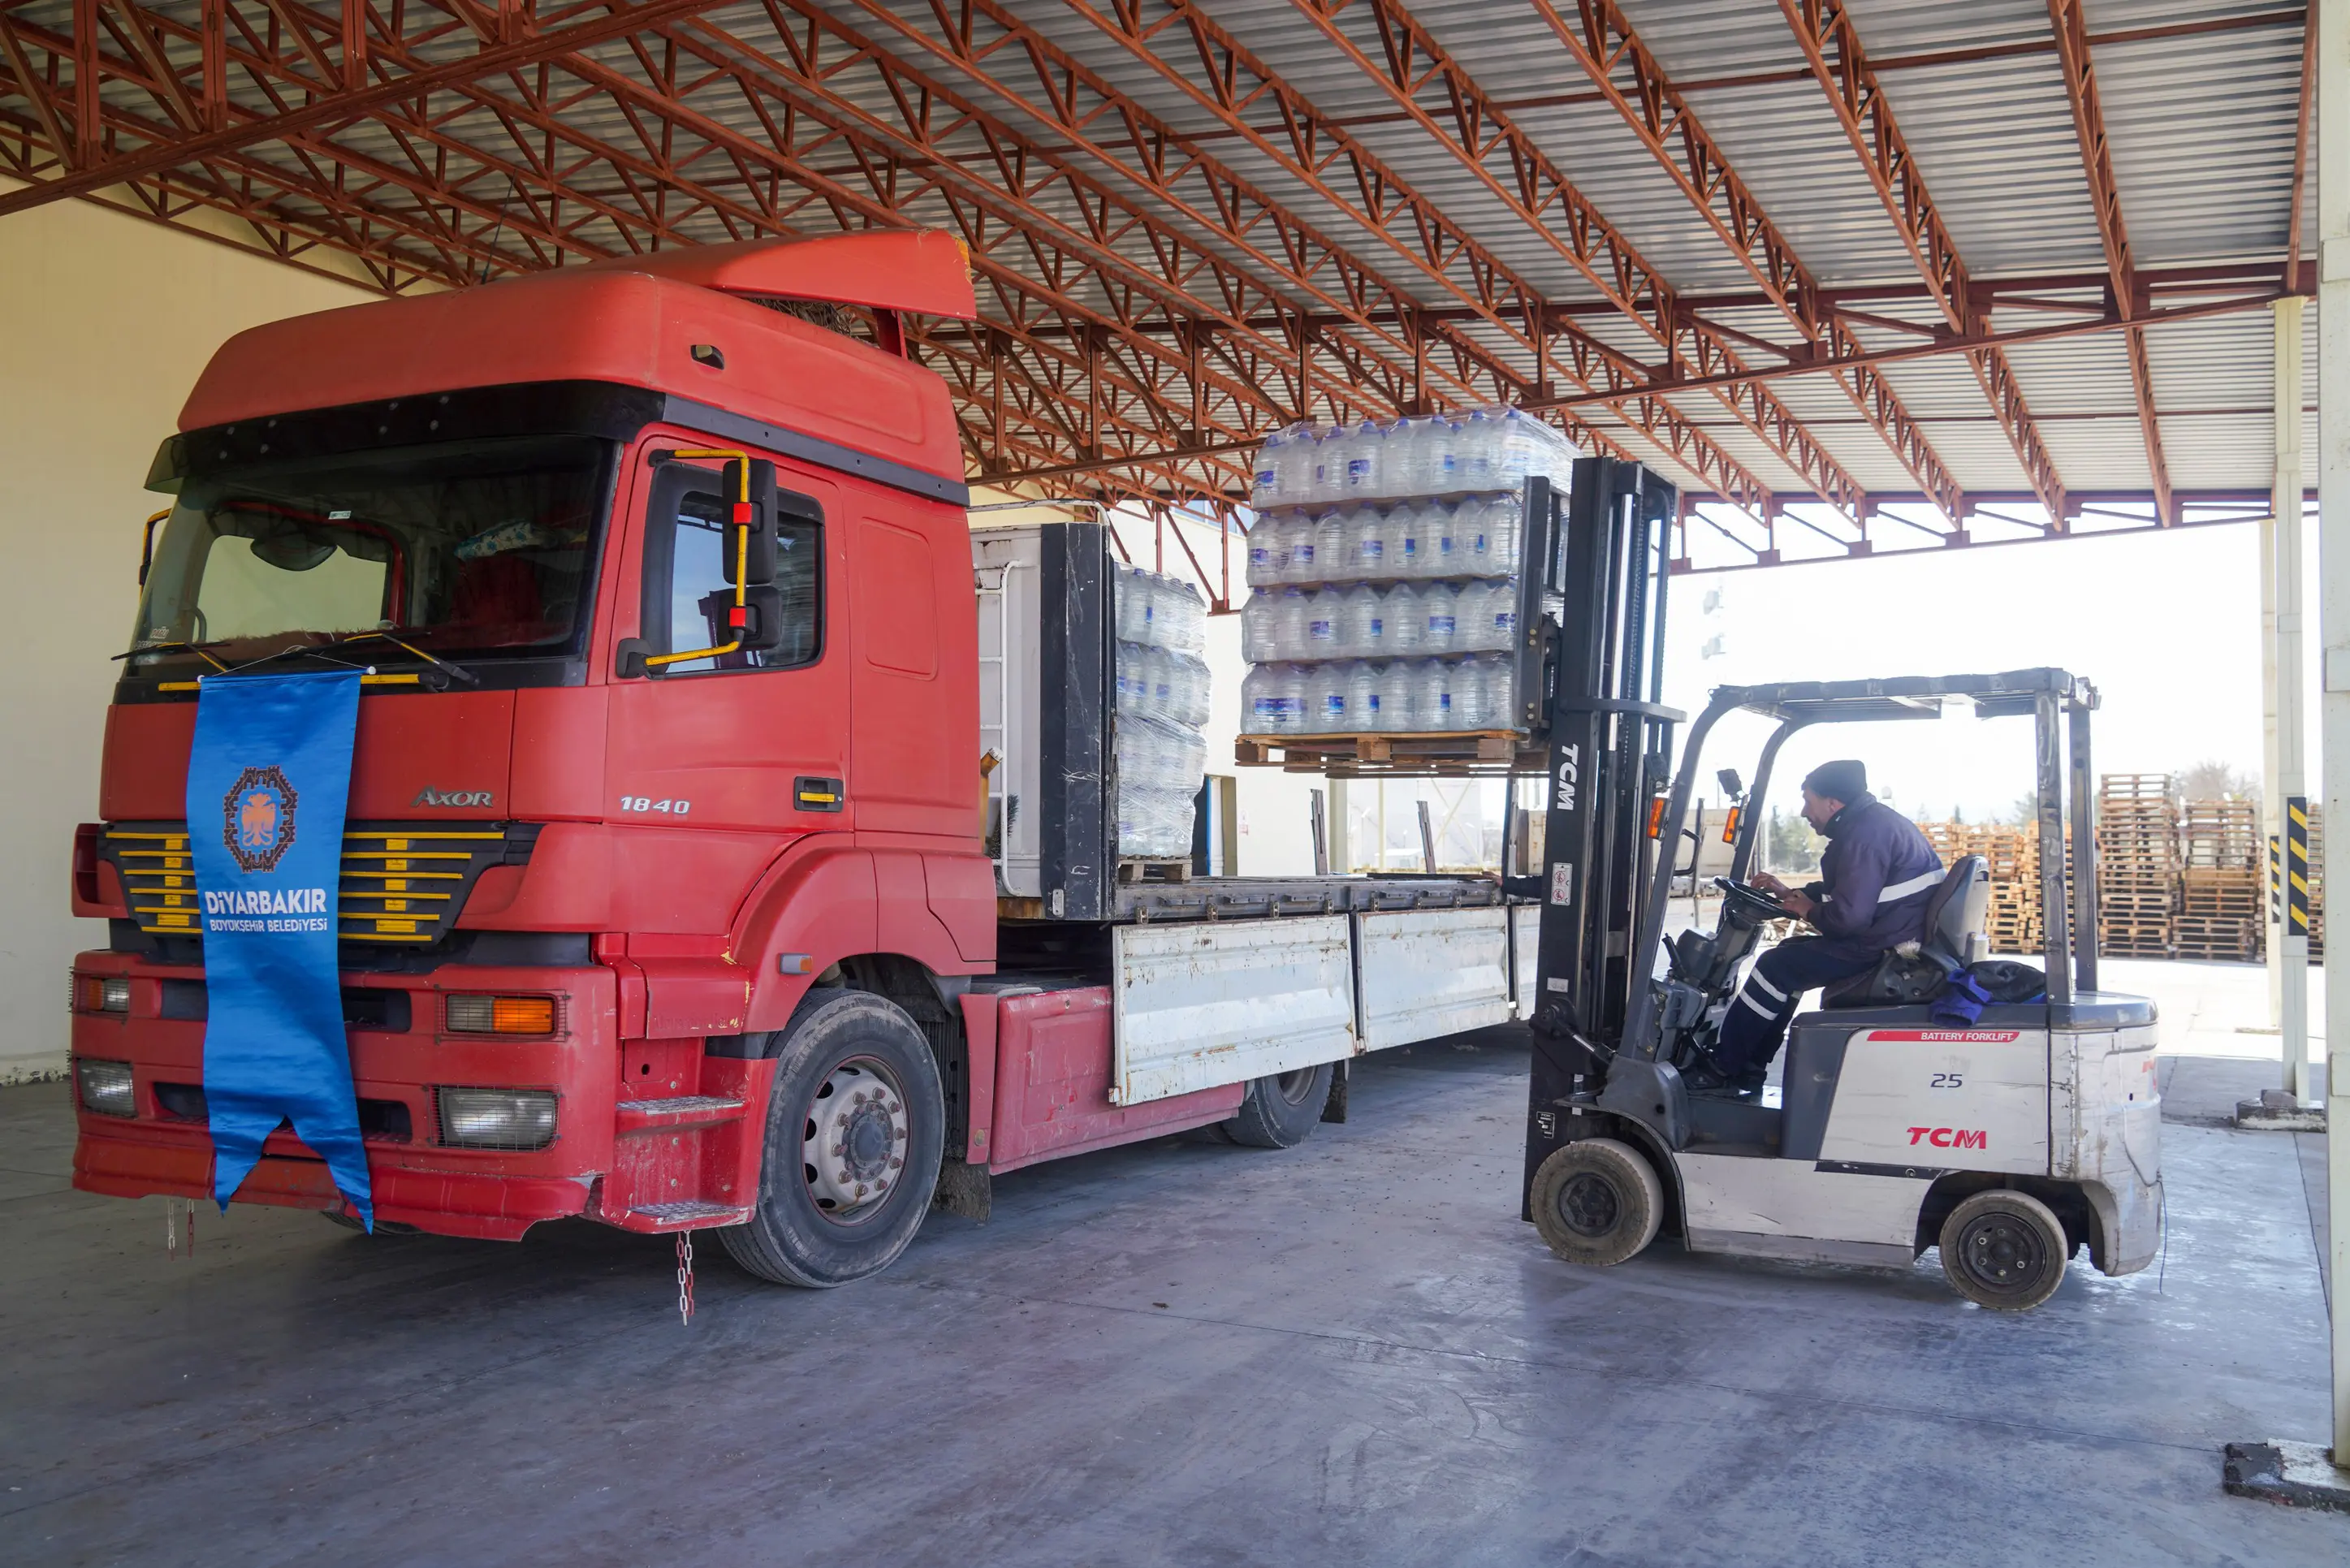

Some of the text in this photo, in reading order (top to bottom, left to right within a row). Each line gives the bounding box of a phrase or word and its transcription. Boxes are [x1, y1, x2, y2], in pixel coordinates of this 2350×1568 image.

[1557, 743, 1579, 810] TCM
[620, 796, 690, 814] 1840
[1920, 1032, 2013, 1042] BATTERY FORKLIFT
[1930, 1073, 1963, 1088] 25
[1907, 1127, 1987, 1149] TCM
